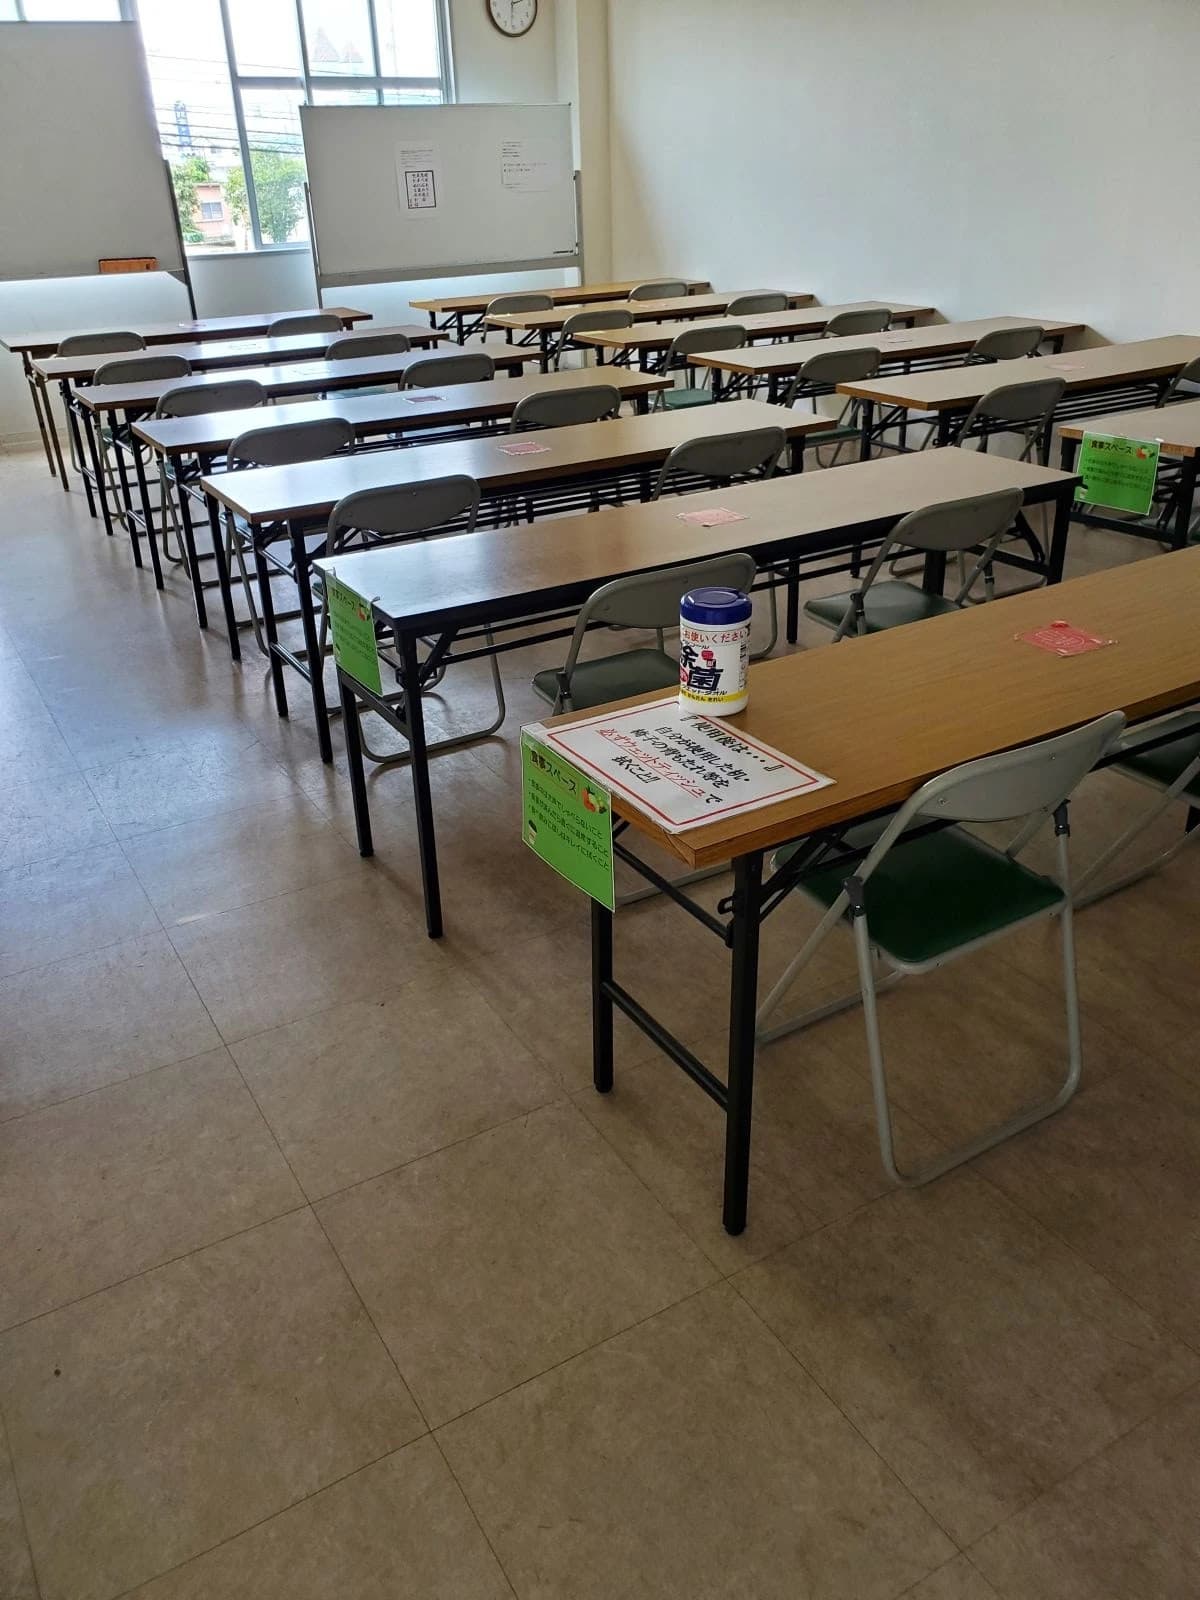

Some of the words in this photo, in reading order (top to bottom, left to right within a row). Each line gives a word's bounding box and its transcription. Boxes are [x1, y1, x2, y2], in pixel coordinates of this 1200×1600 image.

[683, 626, 747, 643] お使いください
[530, 750, 576, 795] 食事スペース
